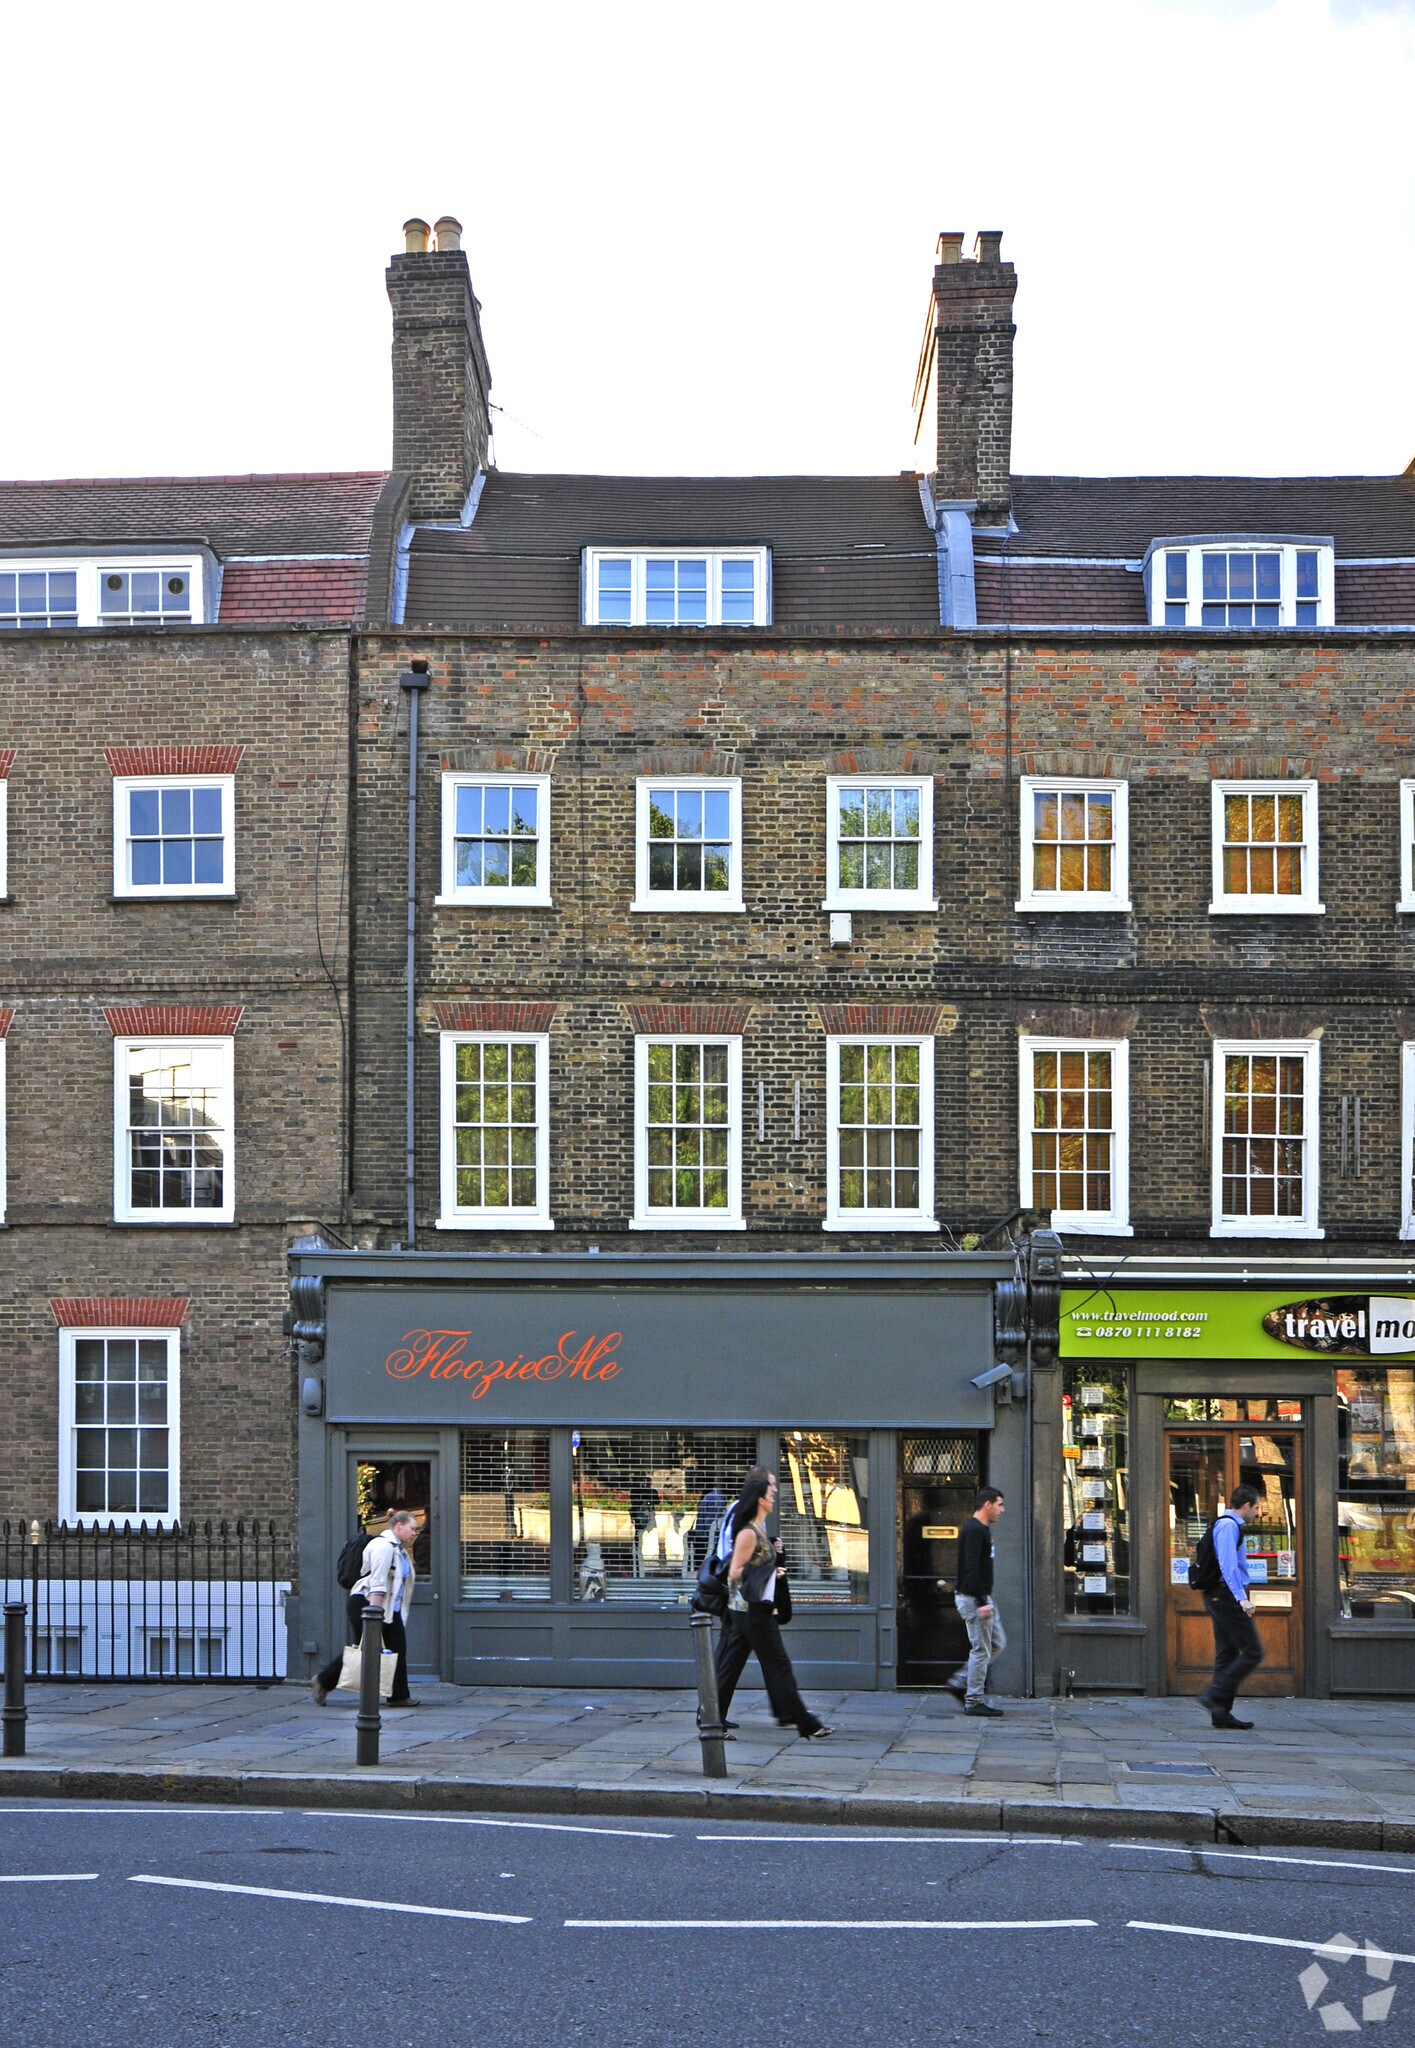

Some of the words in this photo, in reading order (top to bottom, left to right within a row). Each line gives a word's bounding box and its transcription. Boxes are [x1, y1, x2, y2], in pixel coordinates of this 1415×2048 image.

[1071, 1311, 1208, 1322] www.travelmood.com
[1284, 1310, 1366, 1338] travel
[1375, 1319, 1415, 1338] mo
[1095, 1327, 1132, 1338] 0870
[1136, 1327, 1160, 1338] 111
[1164, 1327, 1202, 1338] 8182
